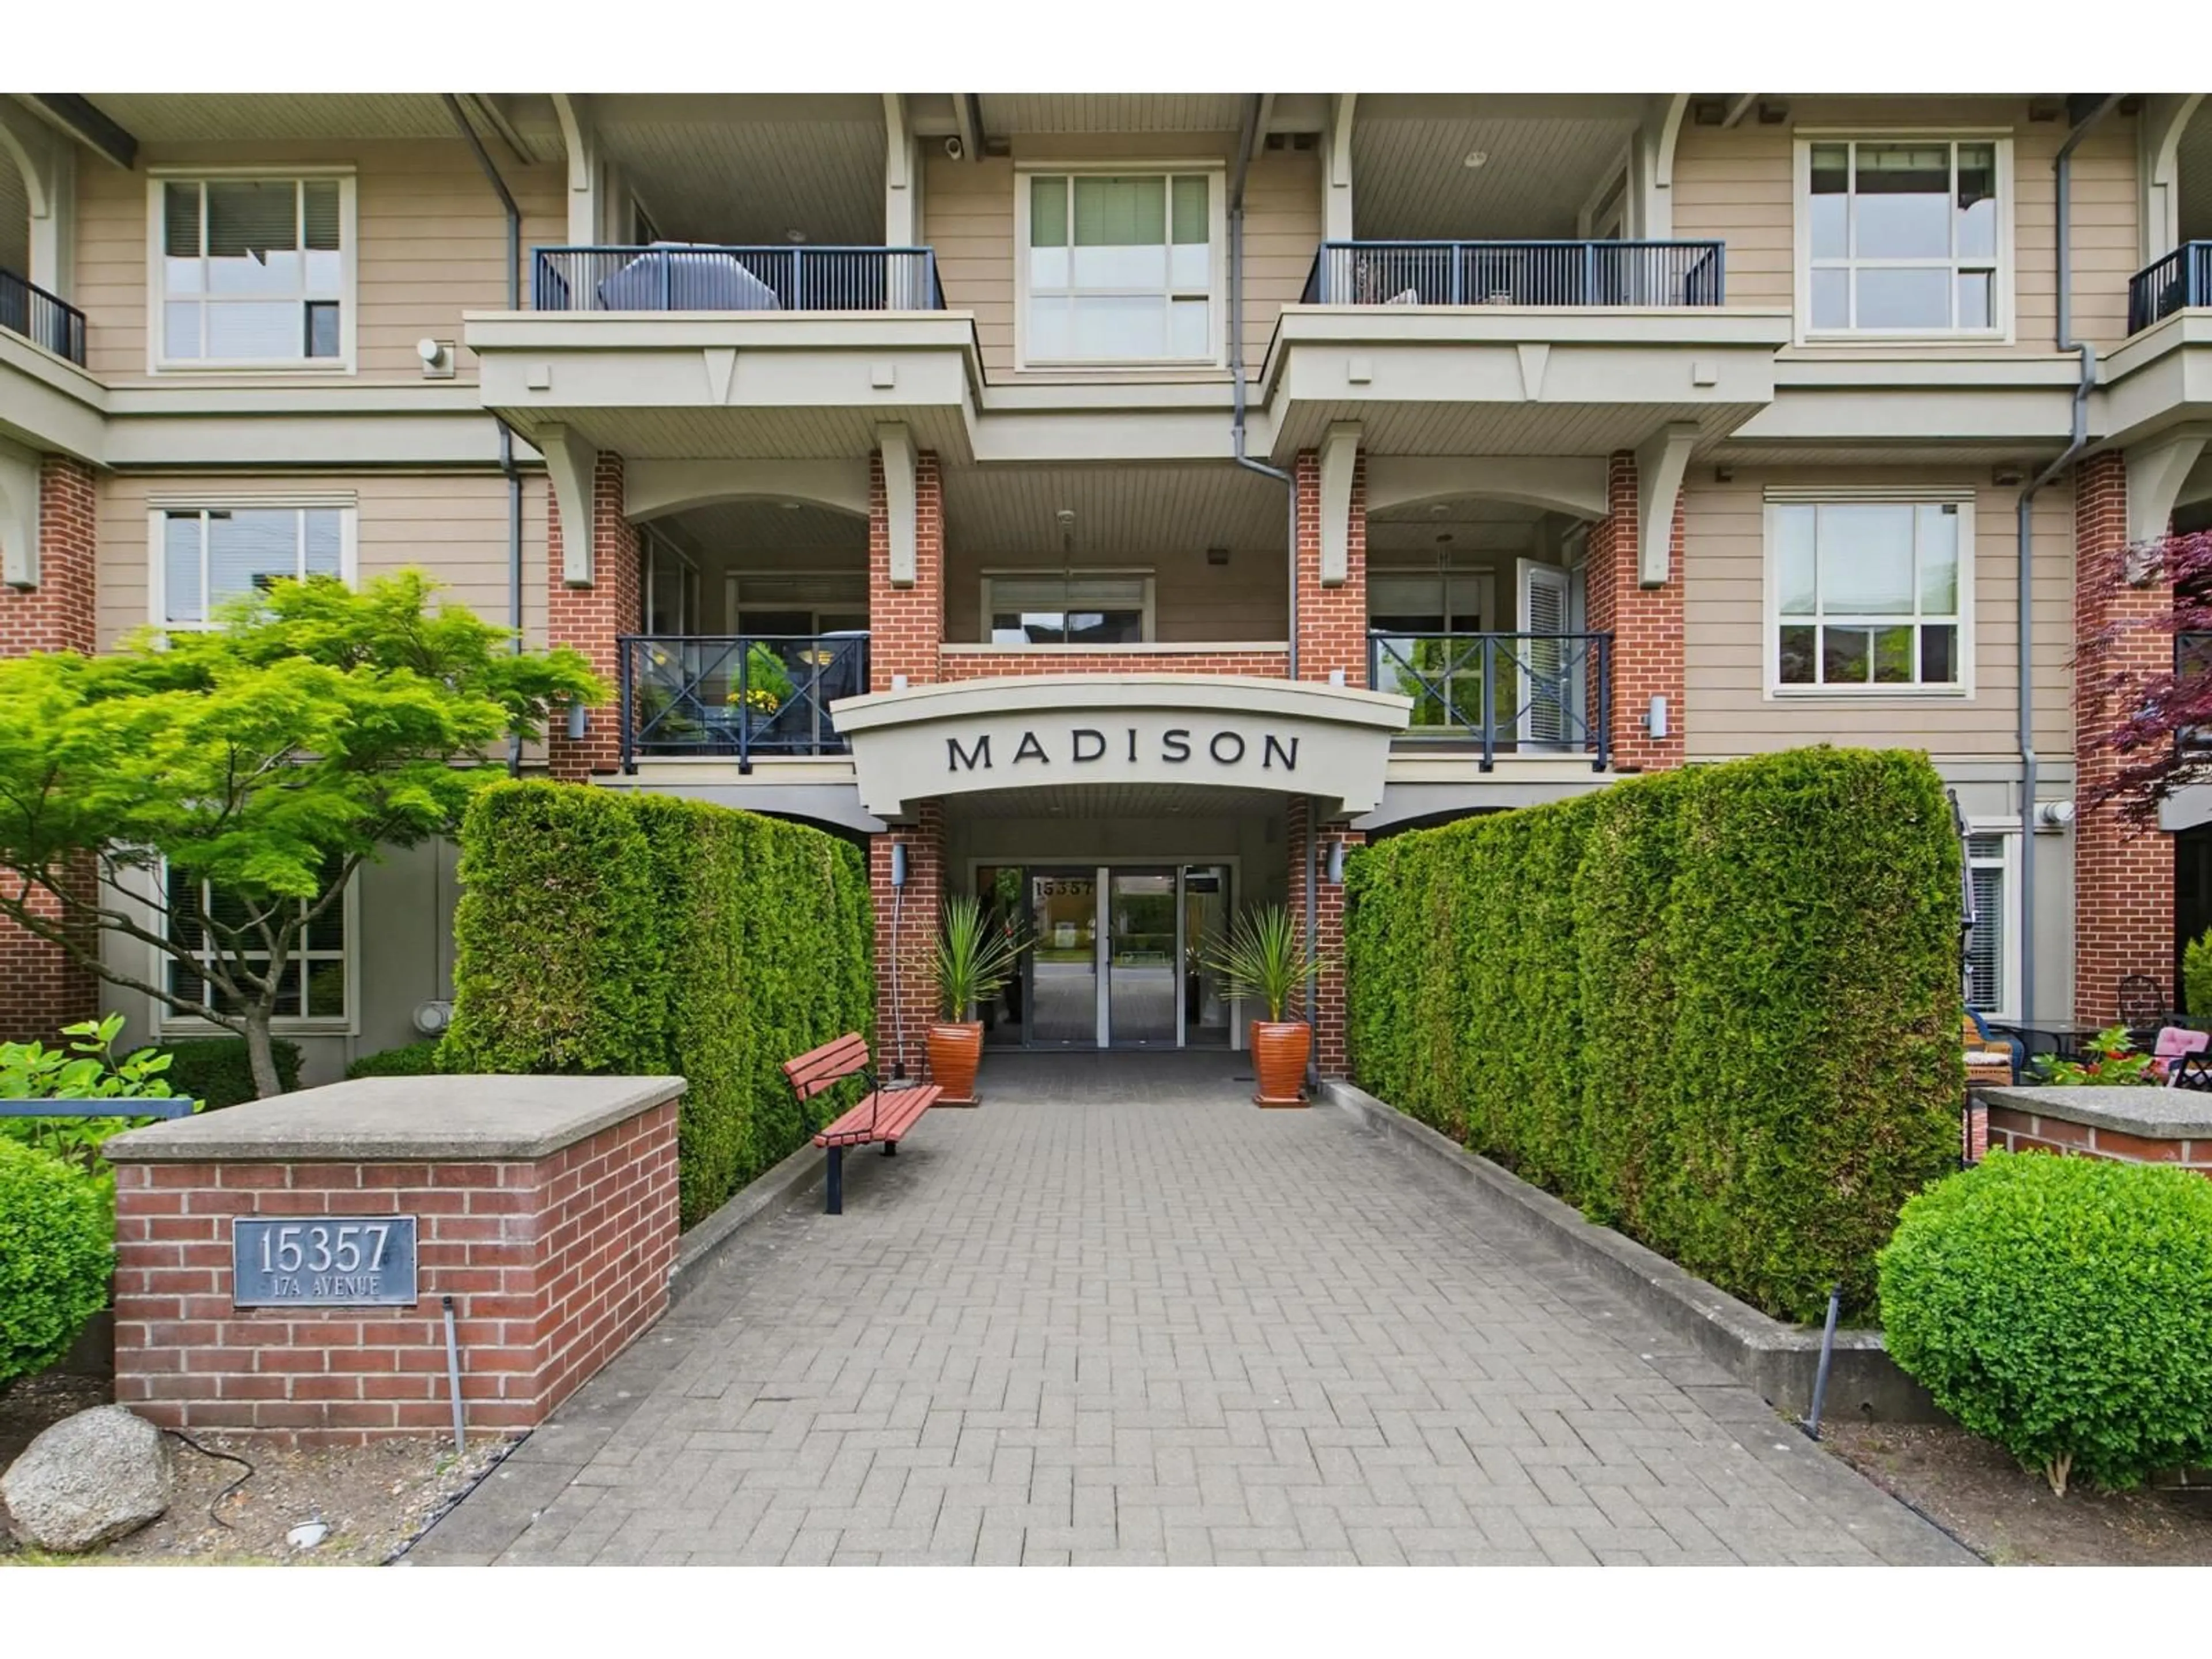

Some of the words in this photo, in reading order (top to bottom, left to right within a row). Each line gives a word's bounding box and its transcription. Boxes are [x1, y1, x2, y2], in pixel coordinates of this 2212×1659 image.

[946, 729, 1299, 771] MADISON
[1036, 881, 1092, 896] 15357
[261, 1225, 389, 1272] 15357
[274, 1277, 301, 1296] 17A
[313, 1276, 381, 1296] AVENUE
